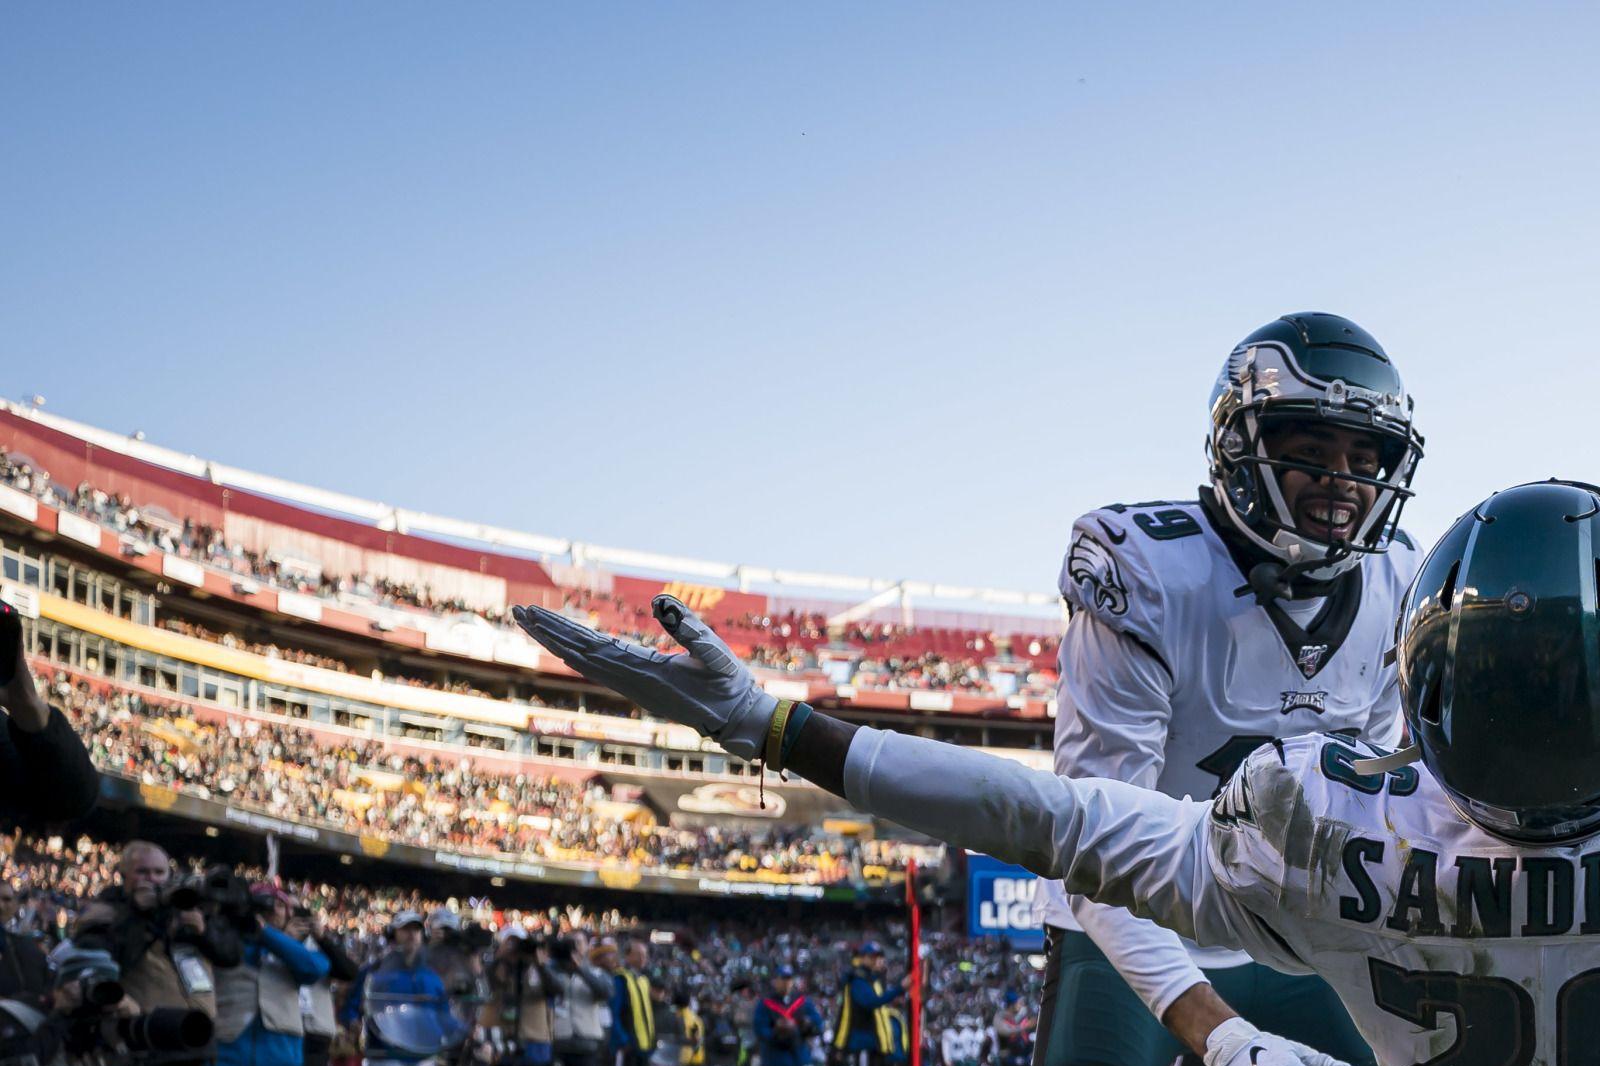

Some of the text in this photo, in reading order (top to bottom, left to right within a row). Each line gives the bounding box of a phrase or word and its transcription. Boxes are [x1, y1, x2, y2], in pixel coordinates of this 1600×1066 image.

[1281, 690, 1329, 715] EAGLES
[980, 877, 1042, 930] BU LIG
